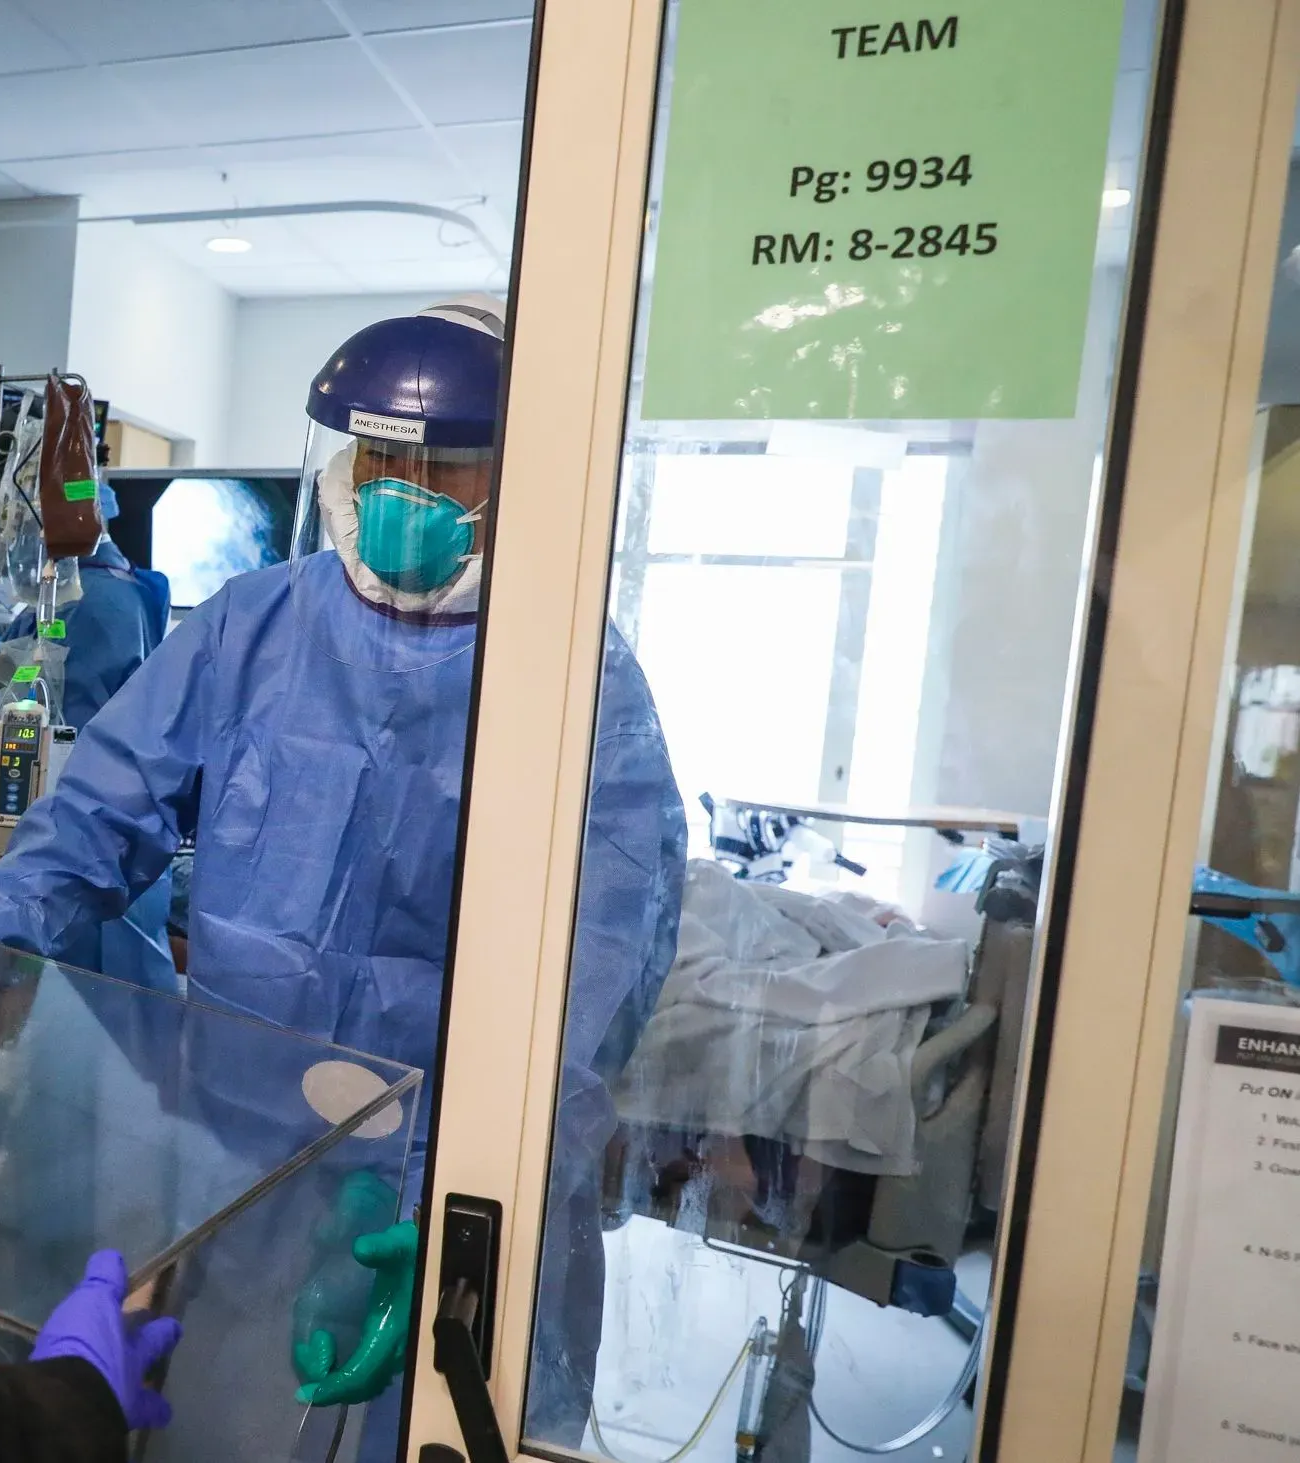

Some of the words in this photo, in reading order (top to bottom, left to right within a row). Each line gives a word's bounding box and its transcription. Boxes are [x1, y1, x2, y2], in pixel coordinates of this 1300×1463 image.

[831, 16, 958, 59] TEAM
[790, 166, 851, 203] Pg:
[866, 154, 973, 193] 9934
[752, 231, 834, 265] RM:
[848, 222, 998, 262] 8-2845
[354, 418, 419, 435] ANESTHESIA
[1268, 1086, 1294, 1099] ON
